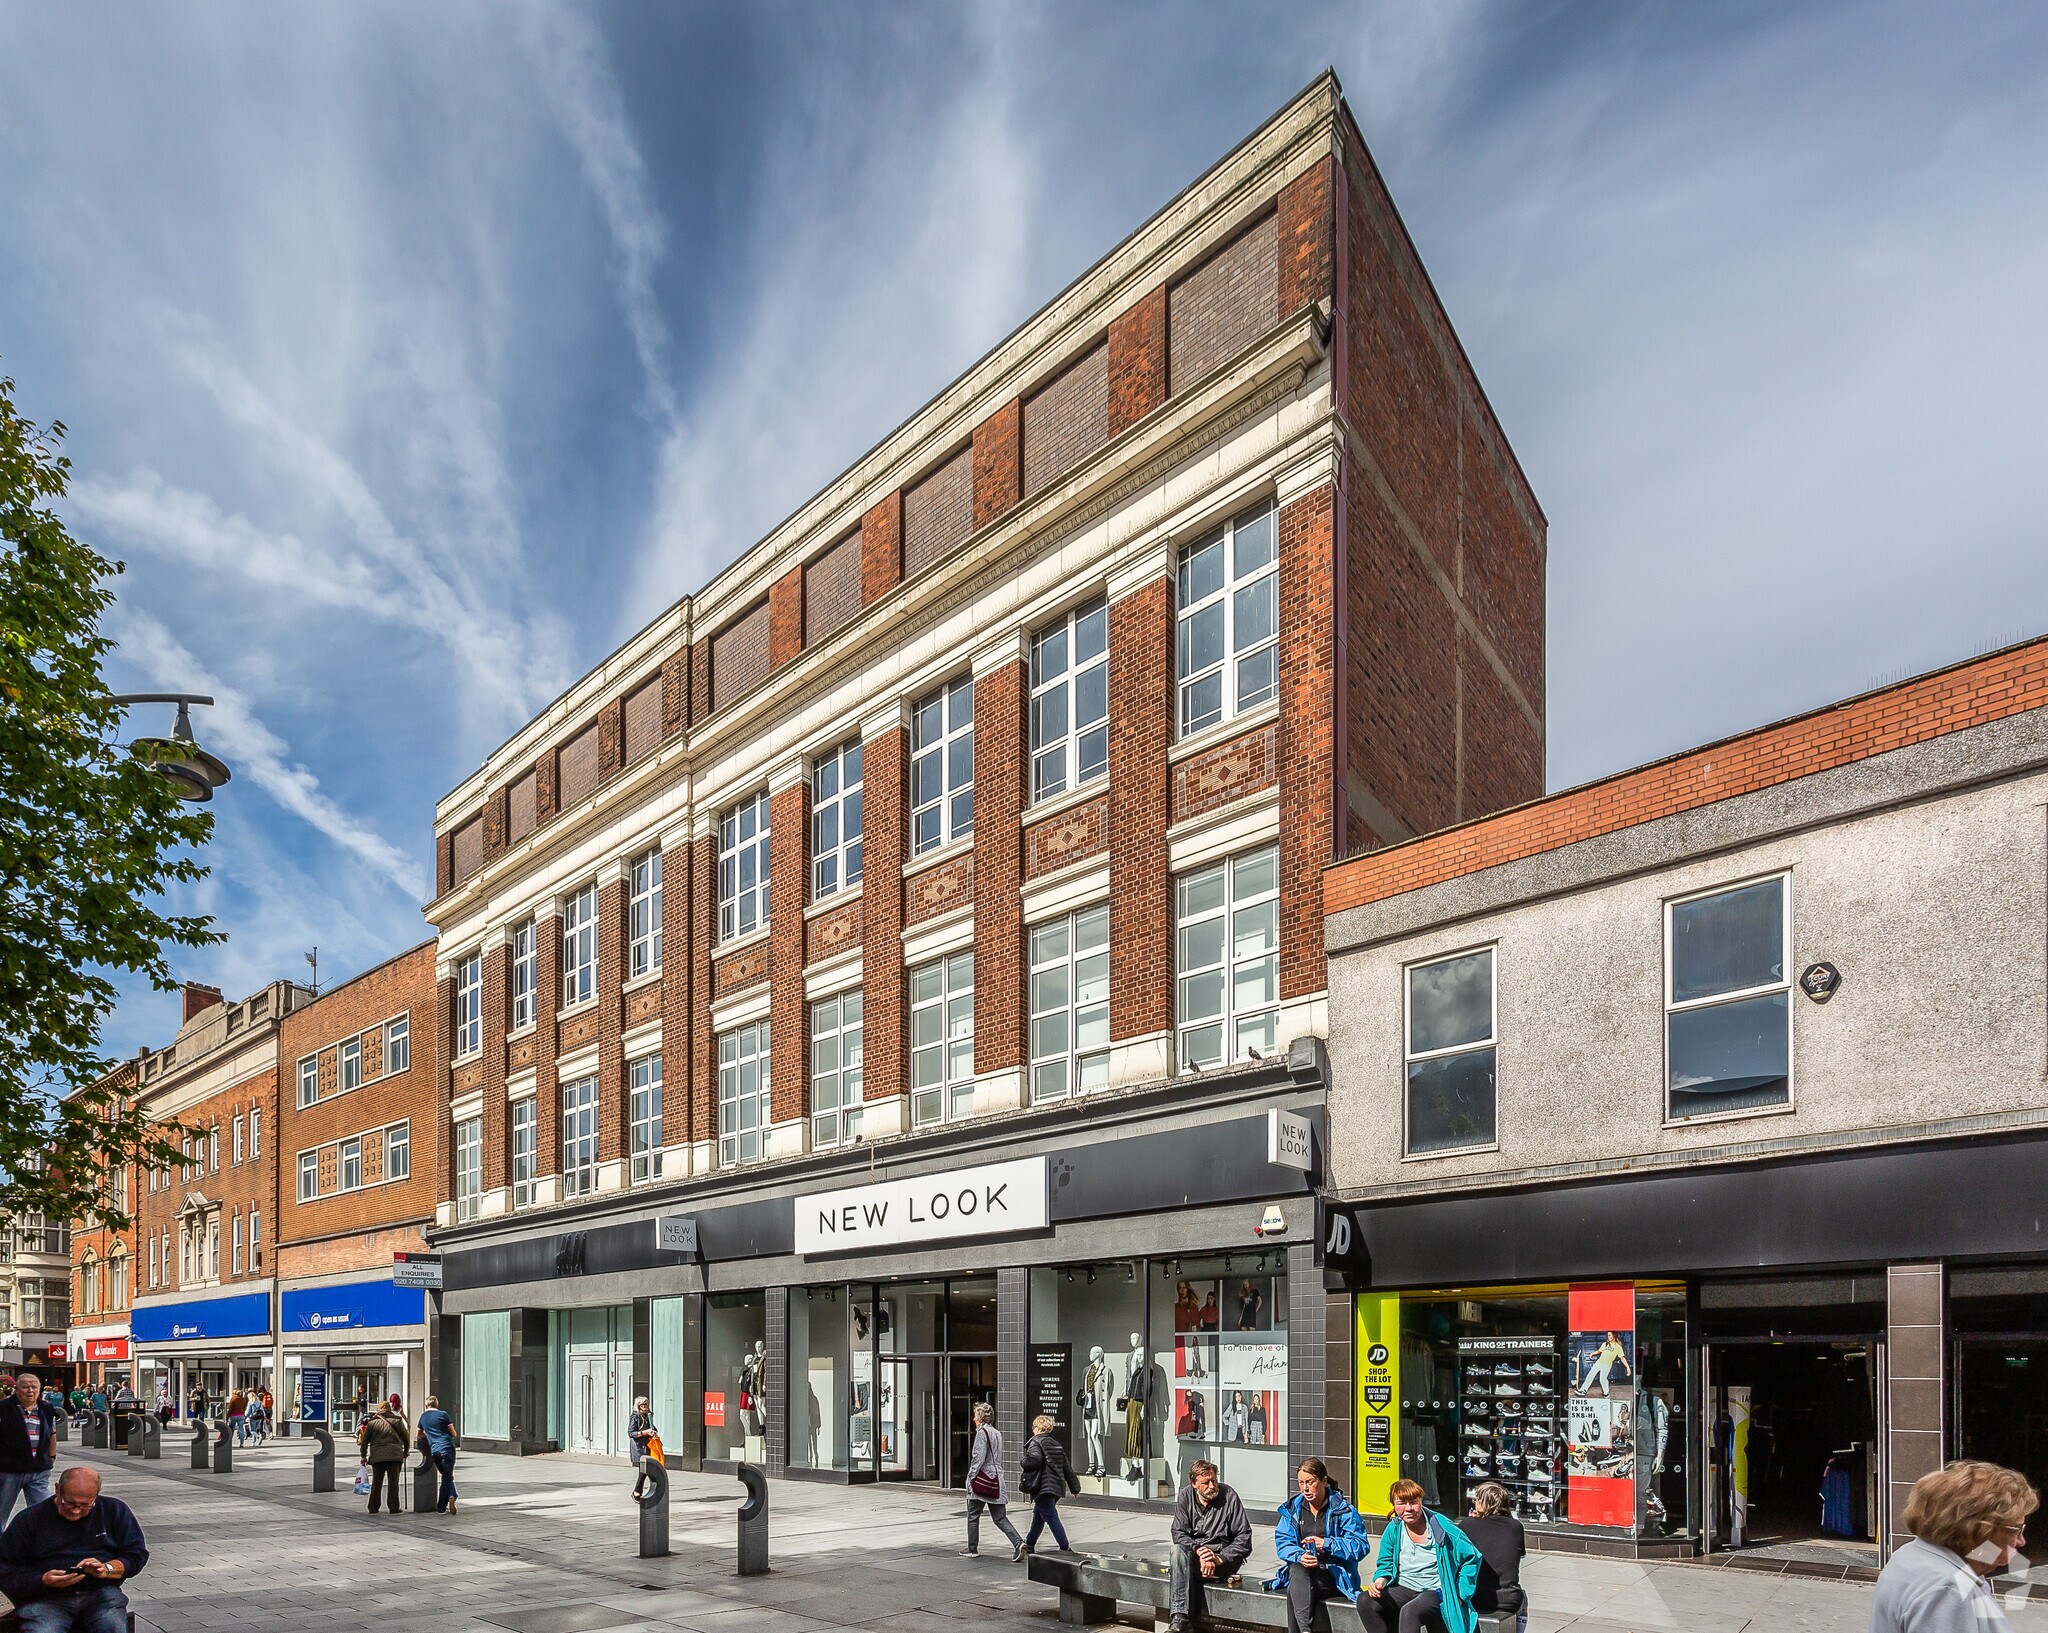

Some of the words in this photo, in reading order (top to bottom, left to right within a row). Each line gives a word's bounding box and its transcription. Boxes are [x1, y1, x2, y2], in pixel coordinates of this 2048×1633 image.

[1282, 1123, 1306, 1141] NEW
[1280, 1138, 1309, 1158] LOOK
[819, 1201, 888, 1234] NEW
[909, 1183, 1008, 1223] LOOK
[665, 1225, 691, 1234] NEW
[1327, 1213, 1351, 1255] JD
[663, 1235, 693, 1244] LOOK
[1370, 1348, 1387, 1361] JD
[706, 1402, 724, 1411] SALE
